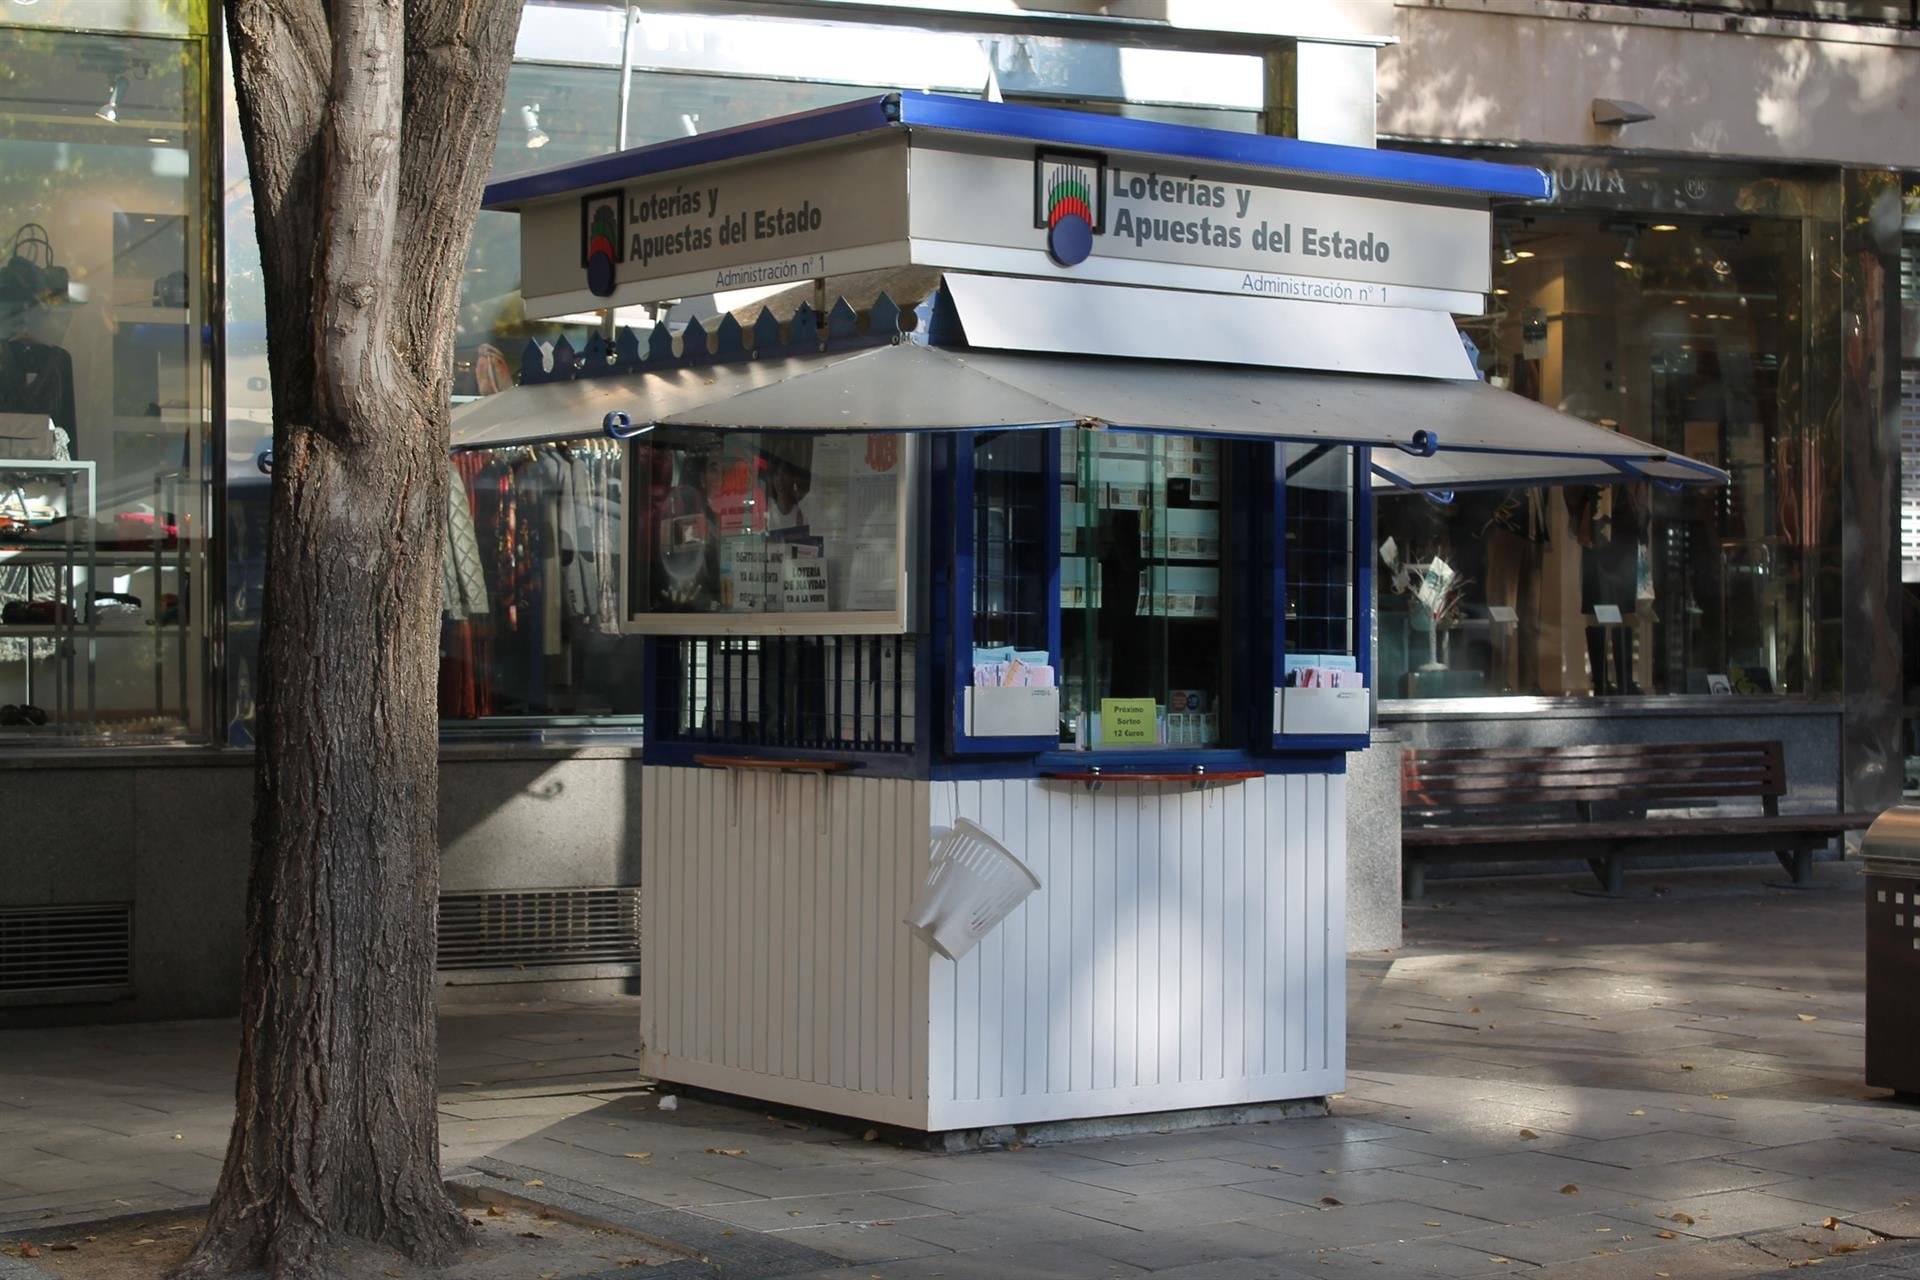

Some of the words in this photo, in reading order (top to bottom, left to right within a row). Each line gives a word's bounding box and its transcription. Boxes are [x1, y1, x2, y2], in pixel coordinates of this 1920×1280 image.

[628, 185, 701, 224] Loterías
[708, 187, 719, 218] y
[1113, 168, 1225, 208] Loterías
[1236, 188, 1252, 219] y
[630, 224, 712, 267] Apuestas
[719, 211, 747, 246] del
[754, 200, 822, 240] Estado
[1113, 208, 1242, 247] Apuestas
[1252, 221, 1291, 253] del
[1302, 227, 1391, 264] Estado
[715, 260, 798, 289] Administración
[820, 256, 825, 272] 1
[1241, 274, 1353, 301] Administración
[1381, 288, 1387, 303] 1
[1114, 729, 1123, 737] 12
